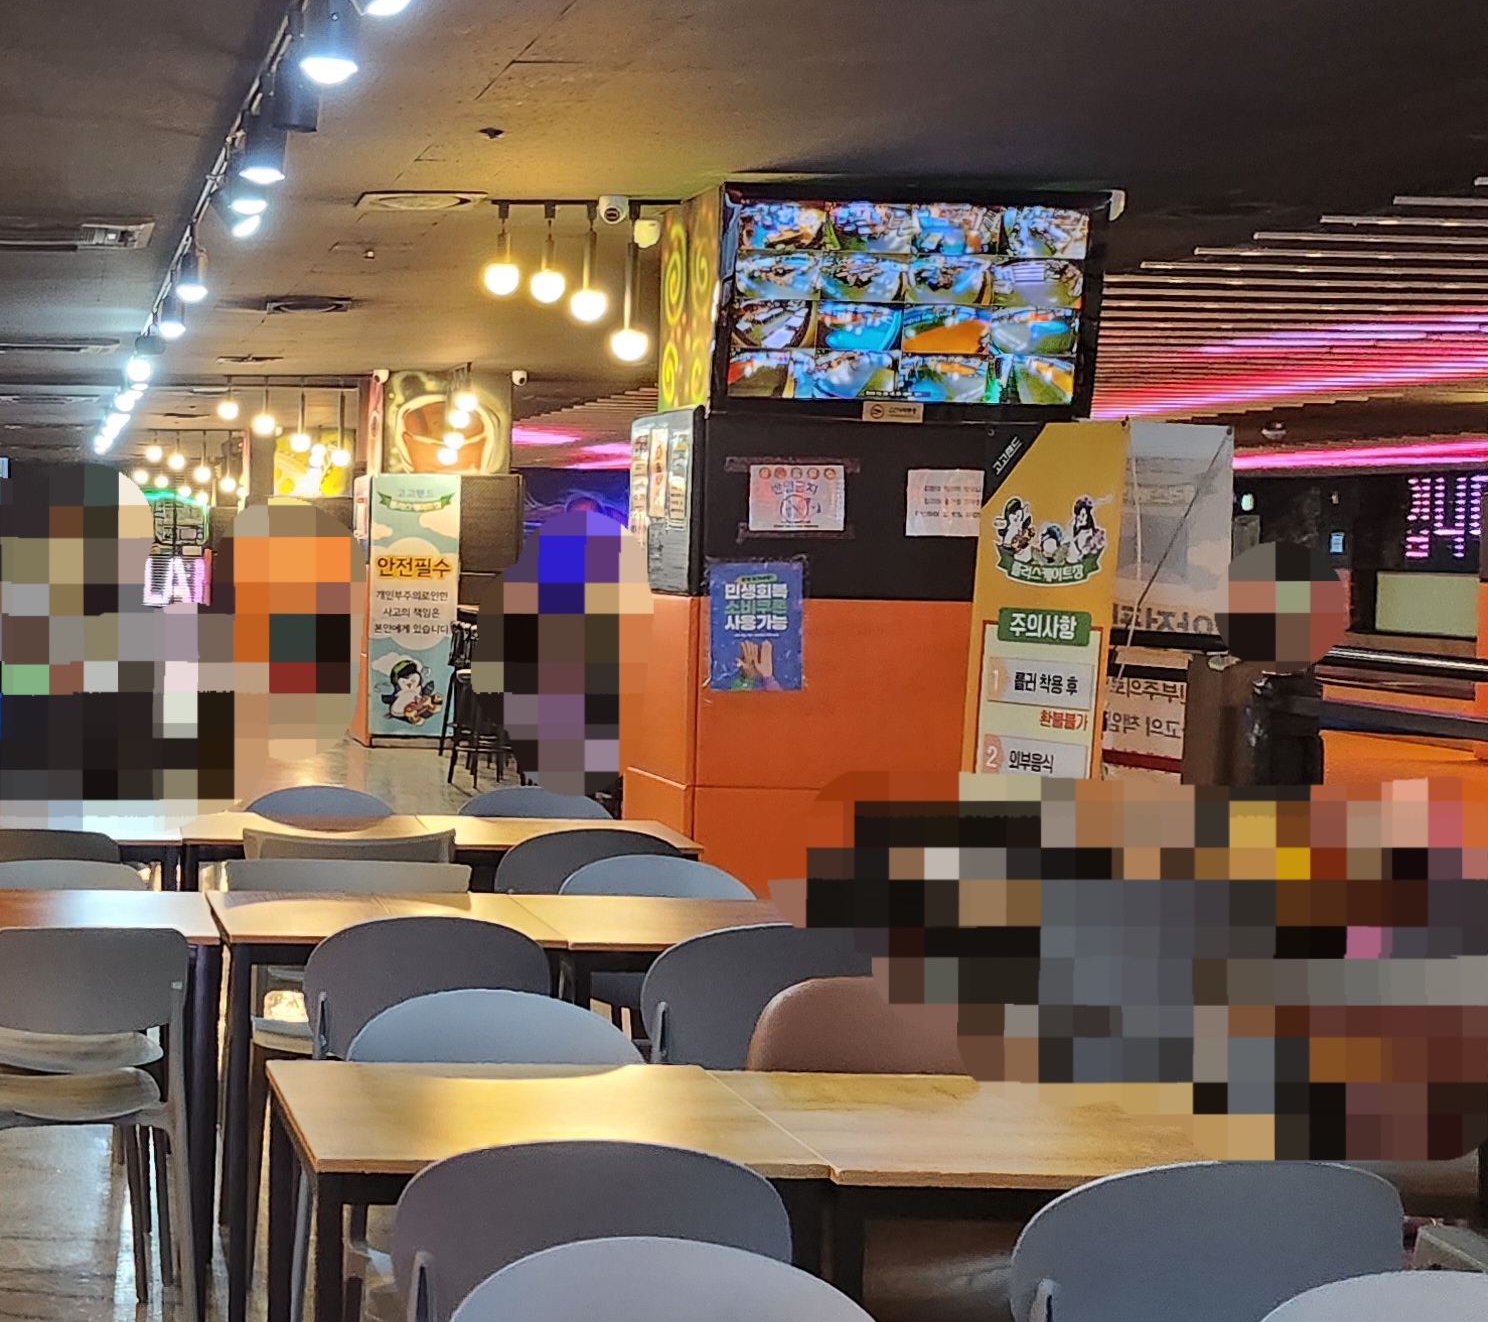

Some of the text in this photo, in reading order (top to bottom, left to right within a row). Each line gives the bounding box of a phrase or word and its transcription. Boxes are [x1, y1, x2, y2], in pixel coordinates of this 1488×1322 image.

[992, 435, 1023, 476] 고고랜드
[376, 557, 452, 579] 안전필수
[1010, 561, 1085, 583] 롤러스케이트장
[724, 583, 788, 600] 민생회복
[383, 607, 441, 619] 사고의 책임은
[724, 599, 787, 615] 소비쿠폰
[724, 614, 788, 631] 사용가능
[1009, 612, 1077, 640] 주의사항
[1014, 671, 1037, 692] 롤러
[1039, 673, 1063, 695] 착용
[1066, 676, 1078, 696] 후
[1038, 708, 1089, 732] 환불불가
[986, 745, 1055, 774] 2 외부음식
